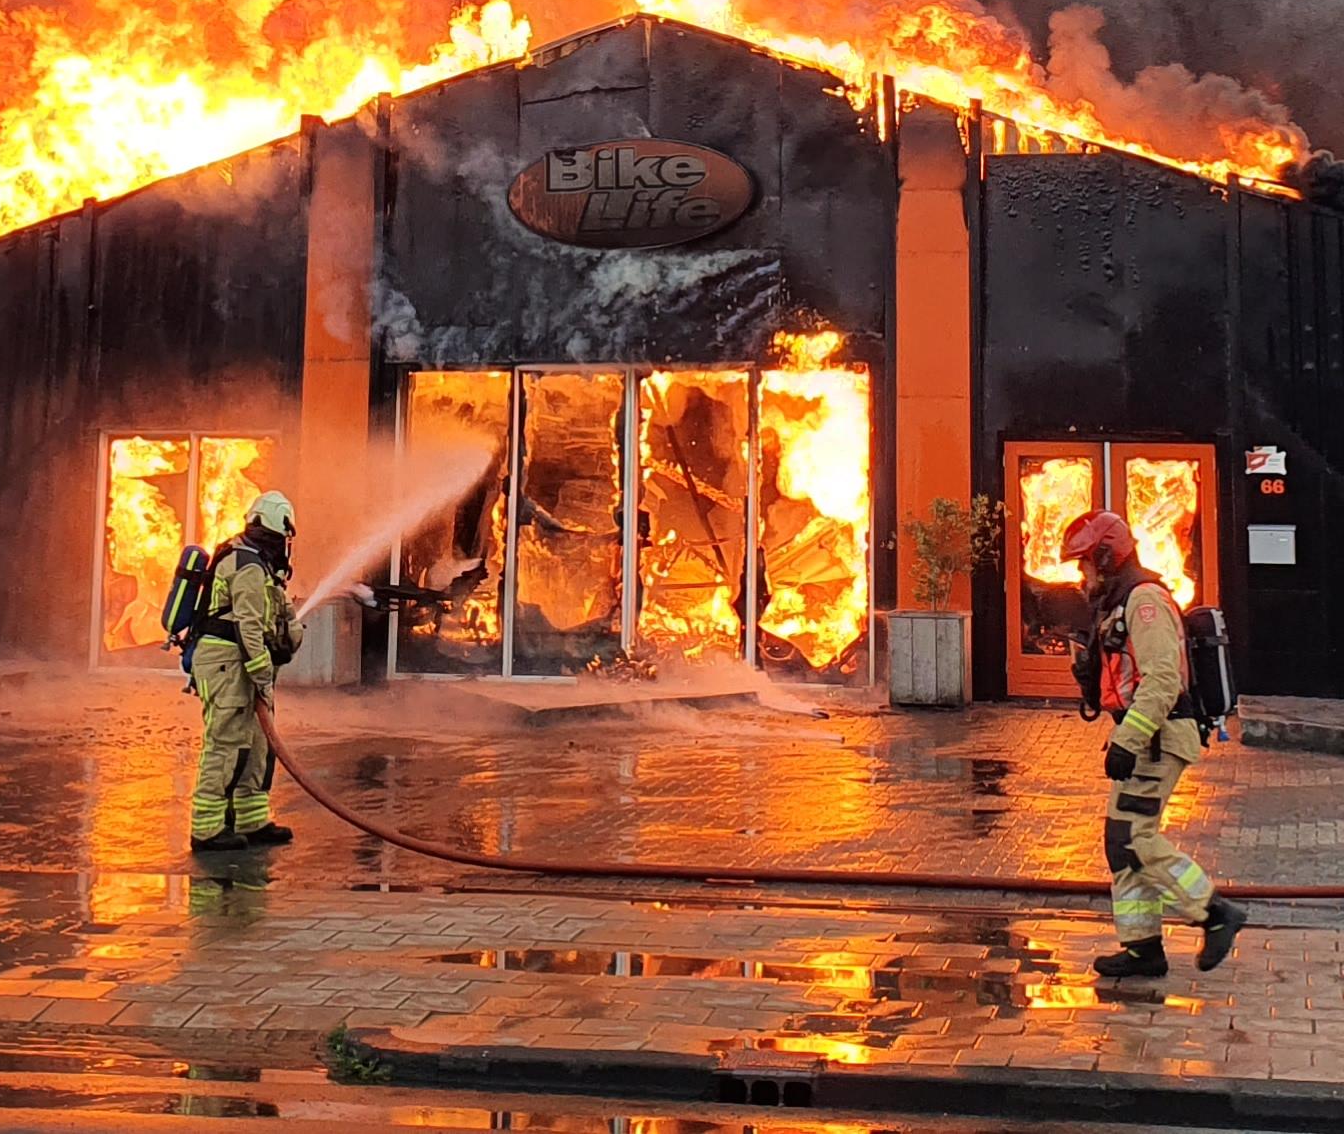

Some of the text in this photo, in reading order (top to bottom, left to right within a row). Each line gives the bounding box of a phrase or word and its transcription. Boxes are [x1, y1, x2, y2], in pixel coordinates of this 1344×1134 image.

[544, 147, 707, 194] Bike
[578, 188, 722, 232] Life
[1260, 479, 1285, 494] 66
